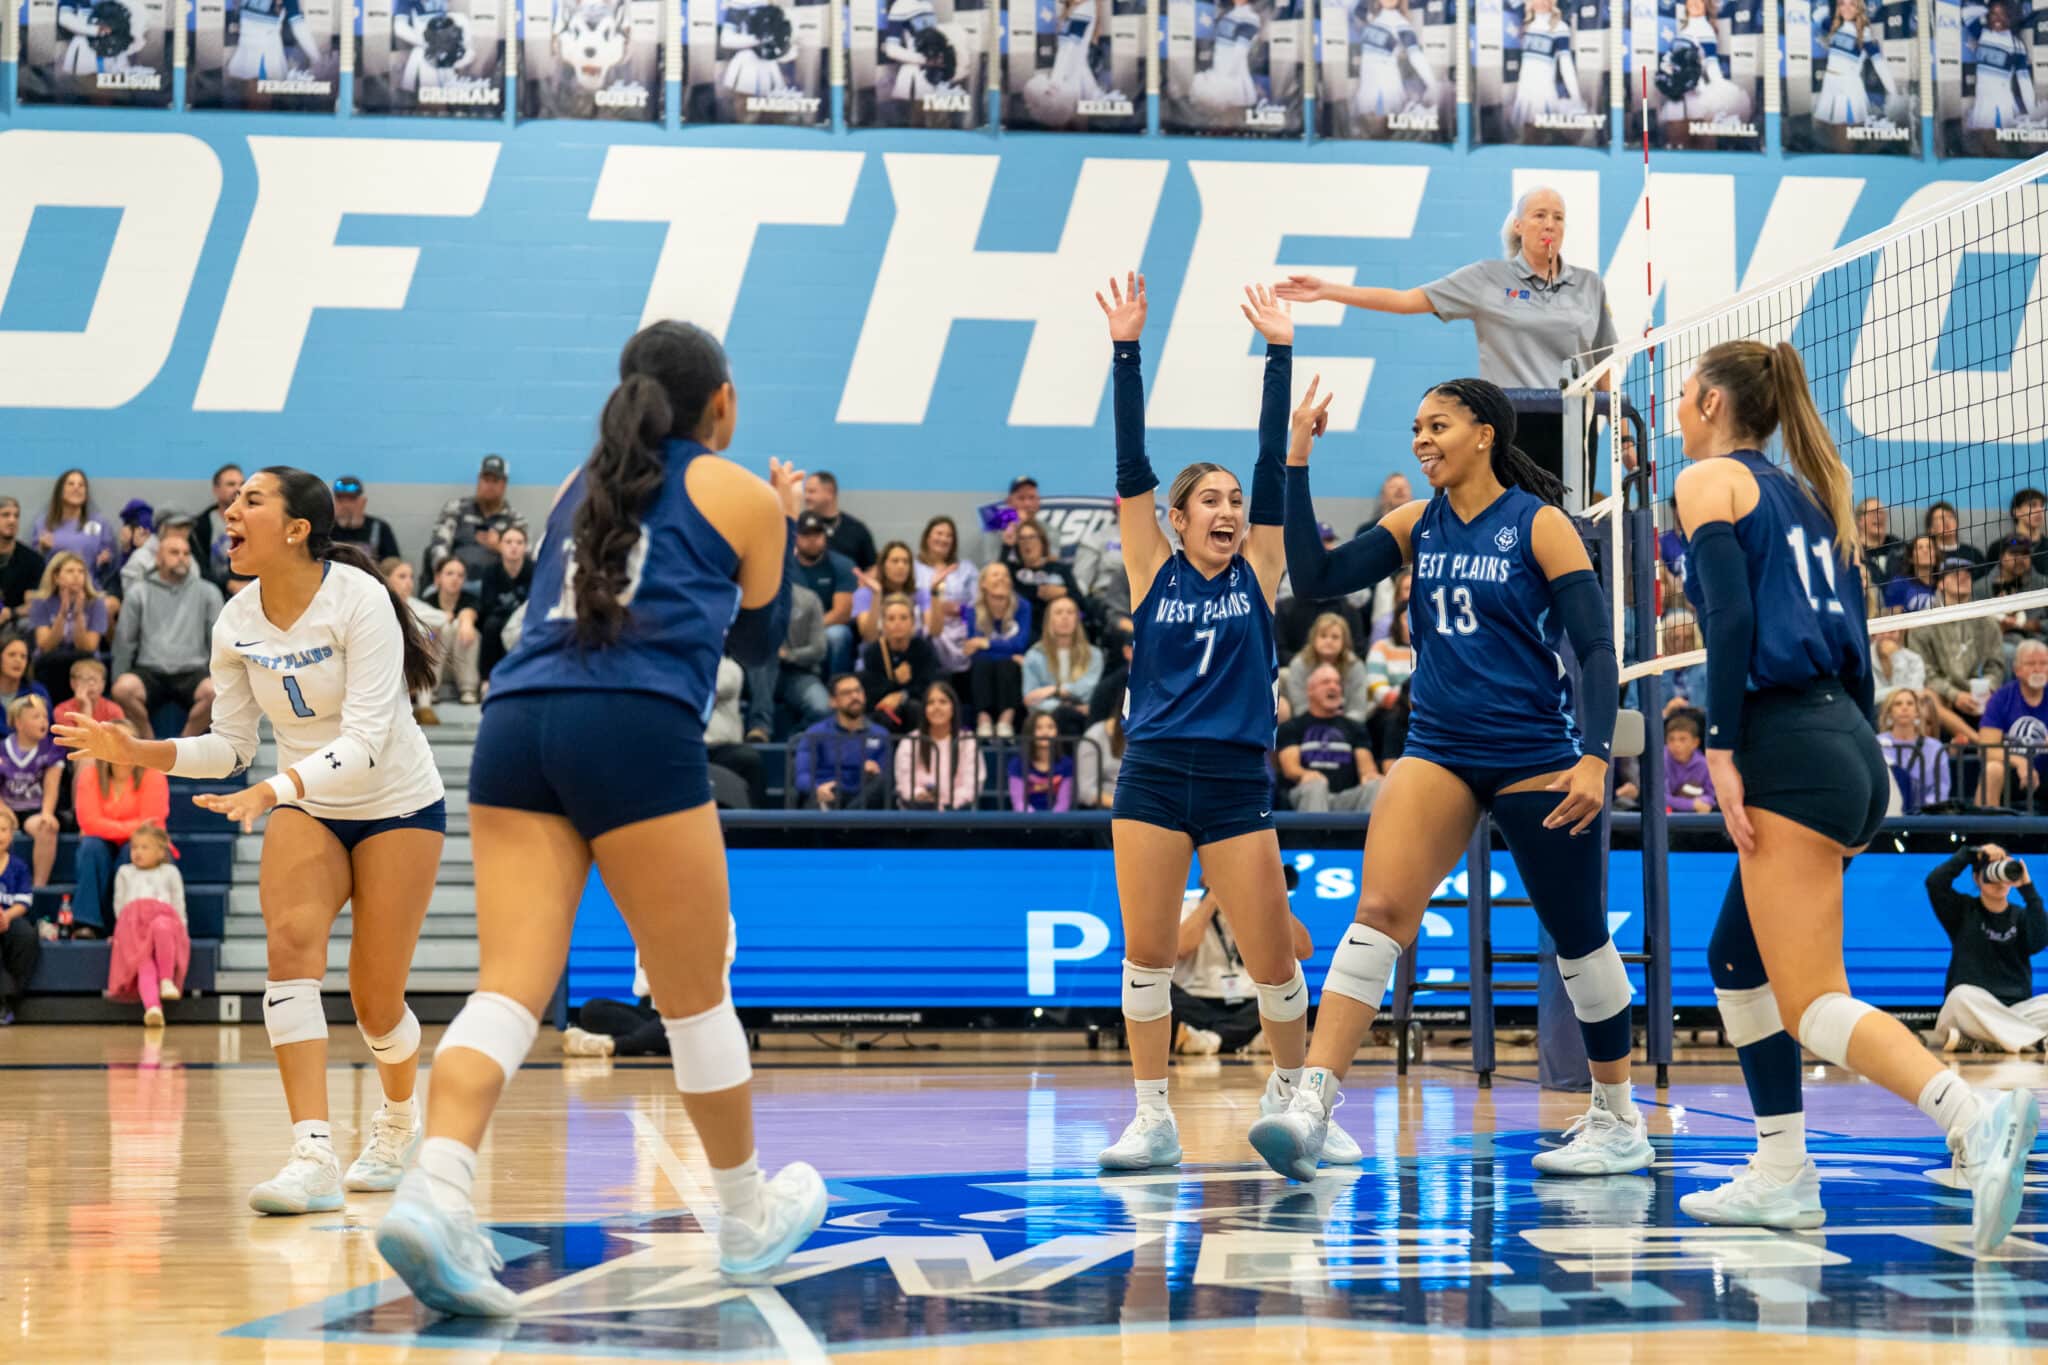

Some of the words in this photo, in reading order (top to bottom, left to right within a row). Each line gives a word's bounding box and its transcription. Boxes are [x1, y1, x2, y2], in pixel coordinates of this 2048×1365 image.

[1388, 113, 1440, 131] LOWE
[1689, 121, 1759, 137] MARSHALL
[588, 144, 1430, 432] THE
[1418, 552, 1447, 579] EST
[1450, 553, 1511, 584] PLAINS
[1786, 524, 1844, 615] 11
[1203, 592, 1251, 624] PLAINS
[1431, 585, 1480, 637] 13
[1194, 627, 1217, 678] 7
[282, 675, 316, 718] 1
